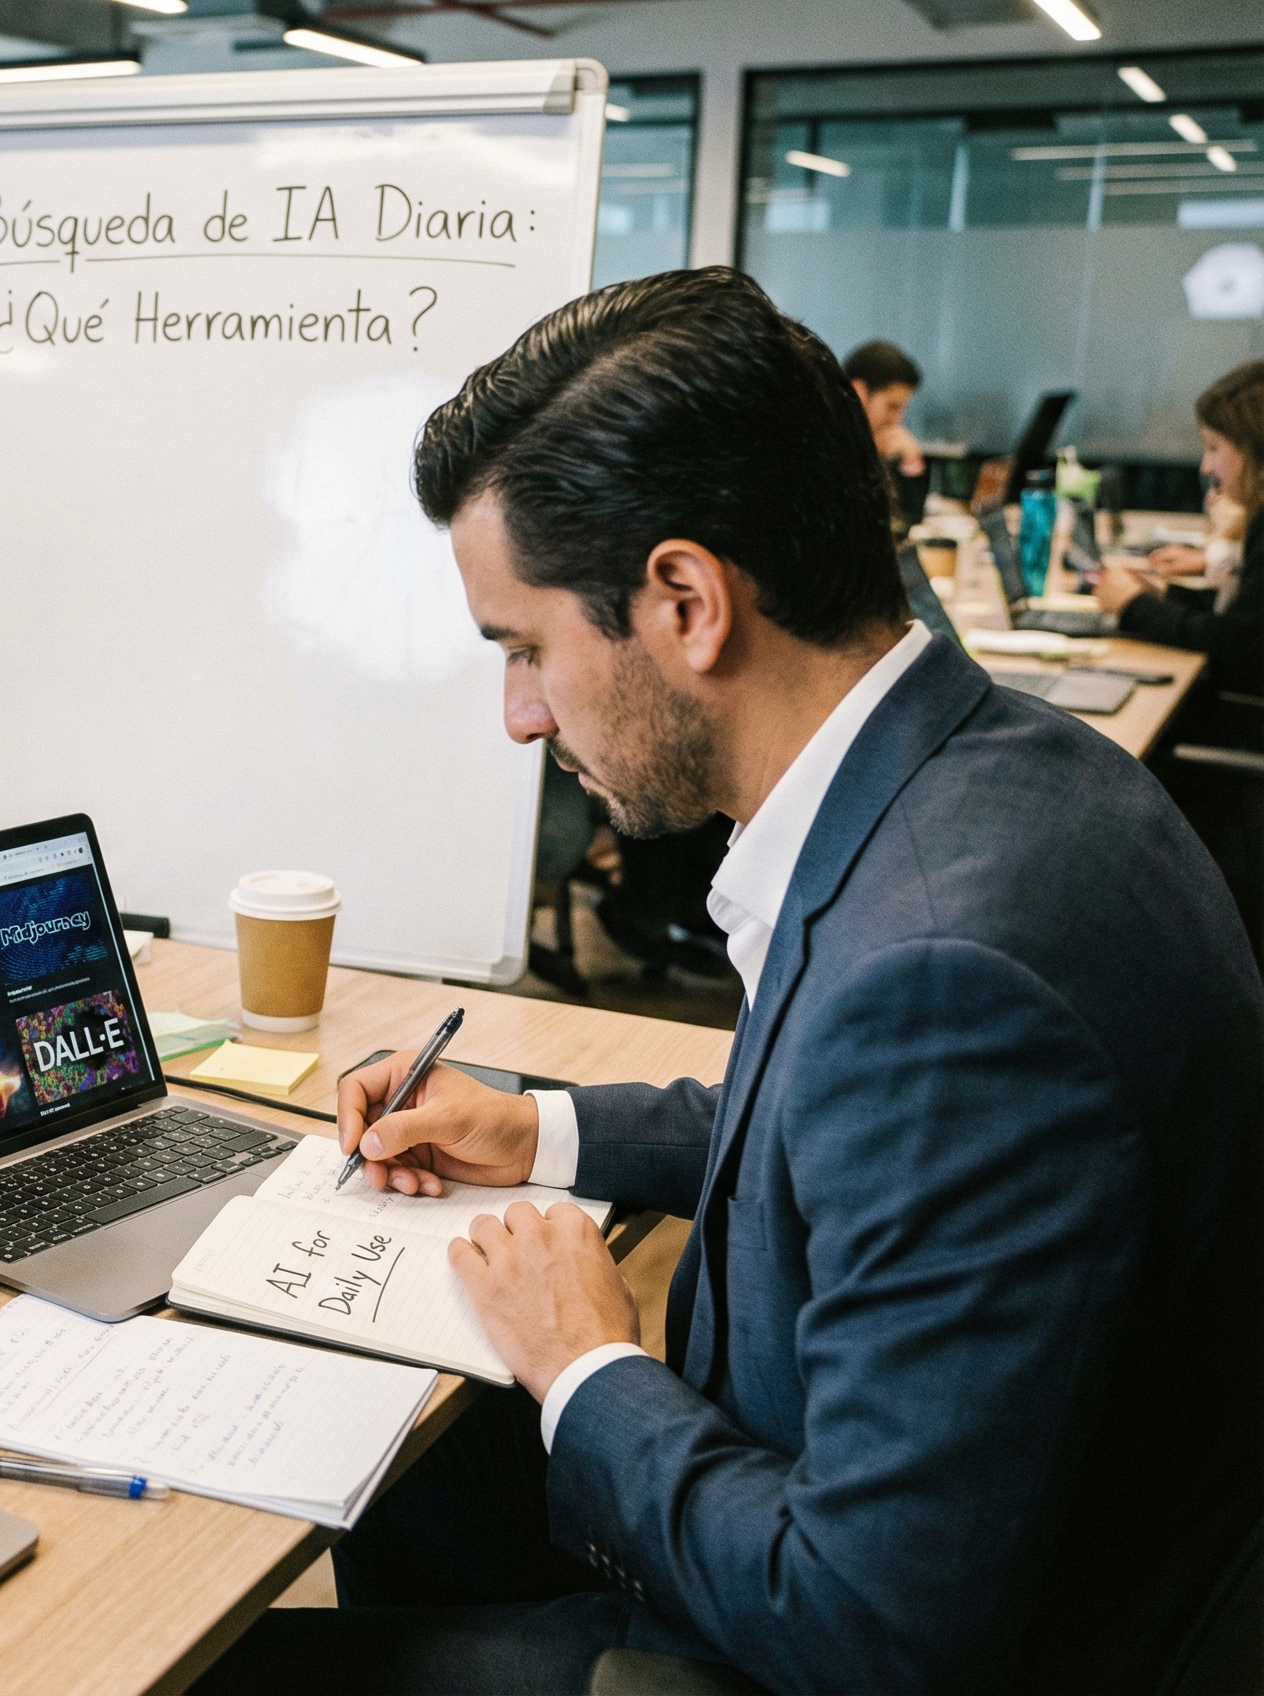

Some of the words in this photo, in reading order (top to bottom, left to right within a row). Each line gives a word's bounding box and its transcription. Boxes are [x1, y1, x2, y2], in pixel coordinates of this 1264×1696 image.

[203, 189, 249, 243] de
[273, 185, 339, 242] IA
[374, 183, 536, 243] Diaria:
[134, 286, 438, 352] Herramienta?
[266, 1263, 312, 1299] AI
[291, 1230, 331, 1257] for
[318, 1270, 382, 1316] Daily
[351, 1235, 393, 1262] Use
